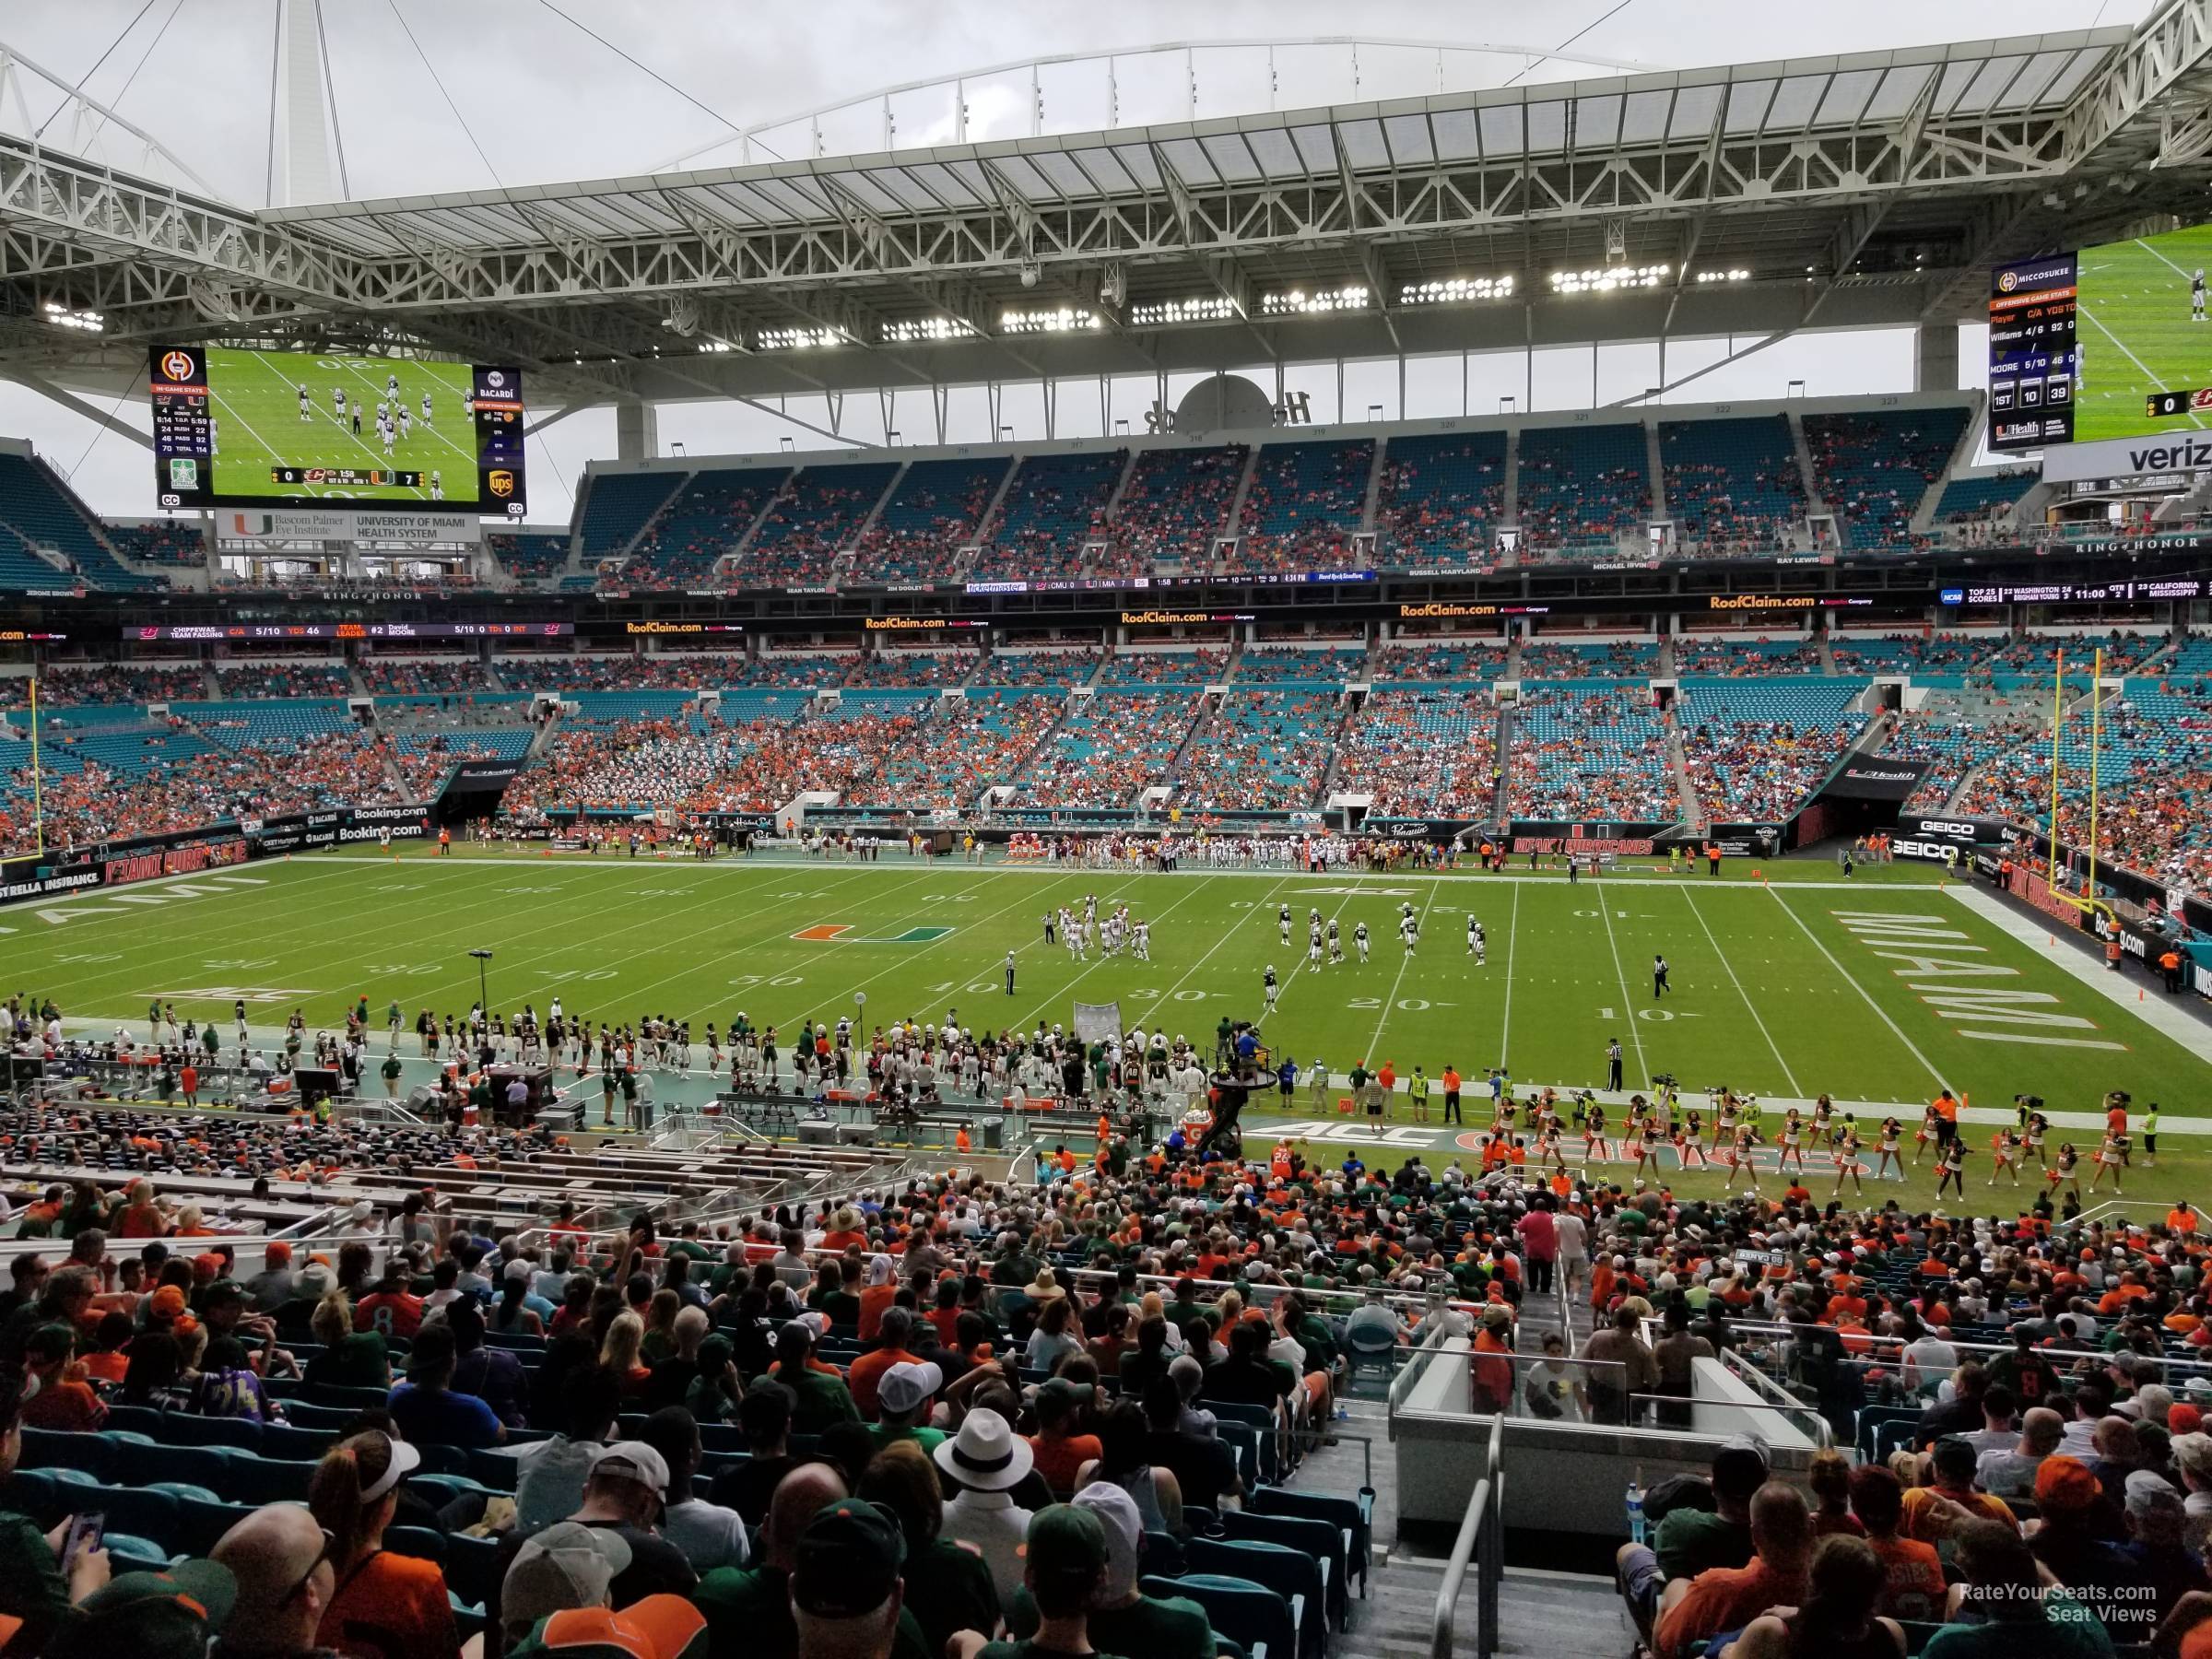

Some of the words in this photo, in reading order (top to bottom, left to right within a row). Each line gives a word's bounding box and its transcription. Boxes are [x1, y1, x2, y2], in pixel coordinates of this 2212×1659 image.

[2018, 266, 2069, 284] MICCOSUKEE
[1990, 313, 2015, 324] Player
[2027, 309, 2042, 320] C/A
[2064, 302, 2076, 313] TD
[1990, 330, 2022, 342] Williams
[2051, 322, 2063, 332] 92
[2067, 320, 2074, 330] 0
[1990, 362, 2018, 374] MOORE
[2052, 355, 2064, 366] 46
[2068, 354, 2075, 364] 0
[480, 388, 514, 398] BACARDÍ
[2024, 391, 2036, 402] 10
[2051, 388, 2065, 399] 39
[1994, 394, 2012, 406] 1ST
[2163, 398, 2174, 412] 0
[285, 471, 293, 482] 0
[340, 470, 355, 478] 1:58
[406, 475, 412, 485] 7
[491, 477, 511, 493] ups
[163, 496, 179, 505] CC
[509, 504, 523, 512] CC
[275, 514, 310, 525] Bascom
[312, 515, 344, 526] Palmer
[357, 516, 416, 527] UNIVERSITY
[417, 517, 430, 527] OF
[431, 518, 465, 528] MIAMI
[275, 525, 291, 536] Eye
[293, 525, 331, 535] Institute
[357, 528, 396, 538] HEALTH
[397, 528, 437, 539] SYSTEM
[2076, 542, 2117, 553] RING
[2134, 537, 2199, 551] HONOR
[1593, 562, 1625, 571] MICHAEL
[968, 583, 1020, 592] ticketmaster
[2148, 582, 2199, 591] CALIFORNIA
[371, 592, 422, 600] HONOR
[2075, 589, 2105, 599] 11:00
[2148, 589, 2196, 597] MISSISSIPPI
[1711, 596, 1817, 609] RoofClaim.com
[1400, 605, 1496, 617] RoofClaim.com
[866, 618, 946, 629] RoofClaim.com
[1122, 612, 1207, 623] RoofClaim.com
[255, 627, 280, 636] 5/10
[306, 627, 319, 635] 46
[371, 626, 383, 634] #2
[505, 625, 511, 633] 0
[627, 622, 702, 633] RoofClaim.com
[355, 806, 427, 819] Booking.com
[1391, 824, 1429, 836] Penguin
[1920, 820, 1975, 835] GEICO
[1565, 838, 1653, 855] HURRICANES
[1893, 840, 1959, 860] GEICO
[727, 974, 806, 986] 50
[925, 981, 1000, 994] 40
[1128, 988, 1209, 1002] 30
[1347, 997, 1429, 1010] 20
[1594, 1007, 1674, 1022] 10
[1190, 1128, 1202, 1140] G
[1246, 1121, 1453, 1146] ACC
[1275, 1152, 1288, 1163] 26
[371, 1305, 393, 1335] 8
